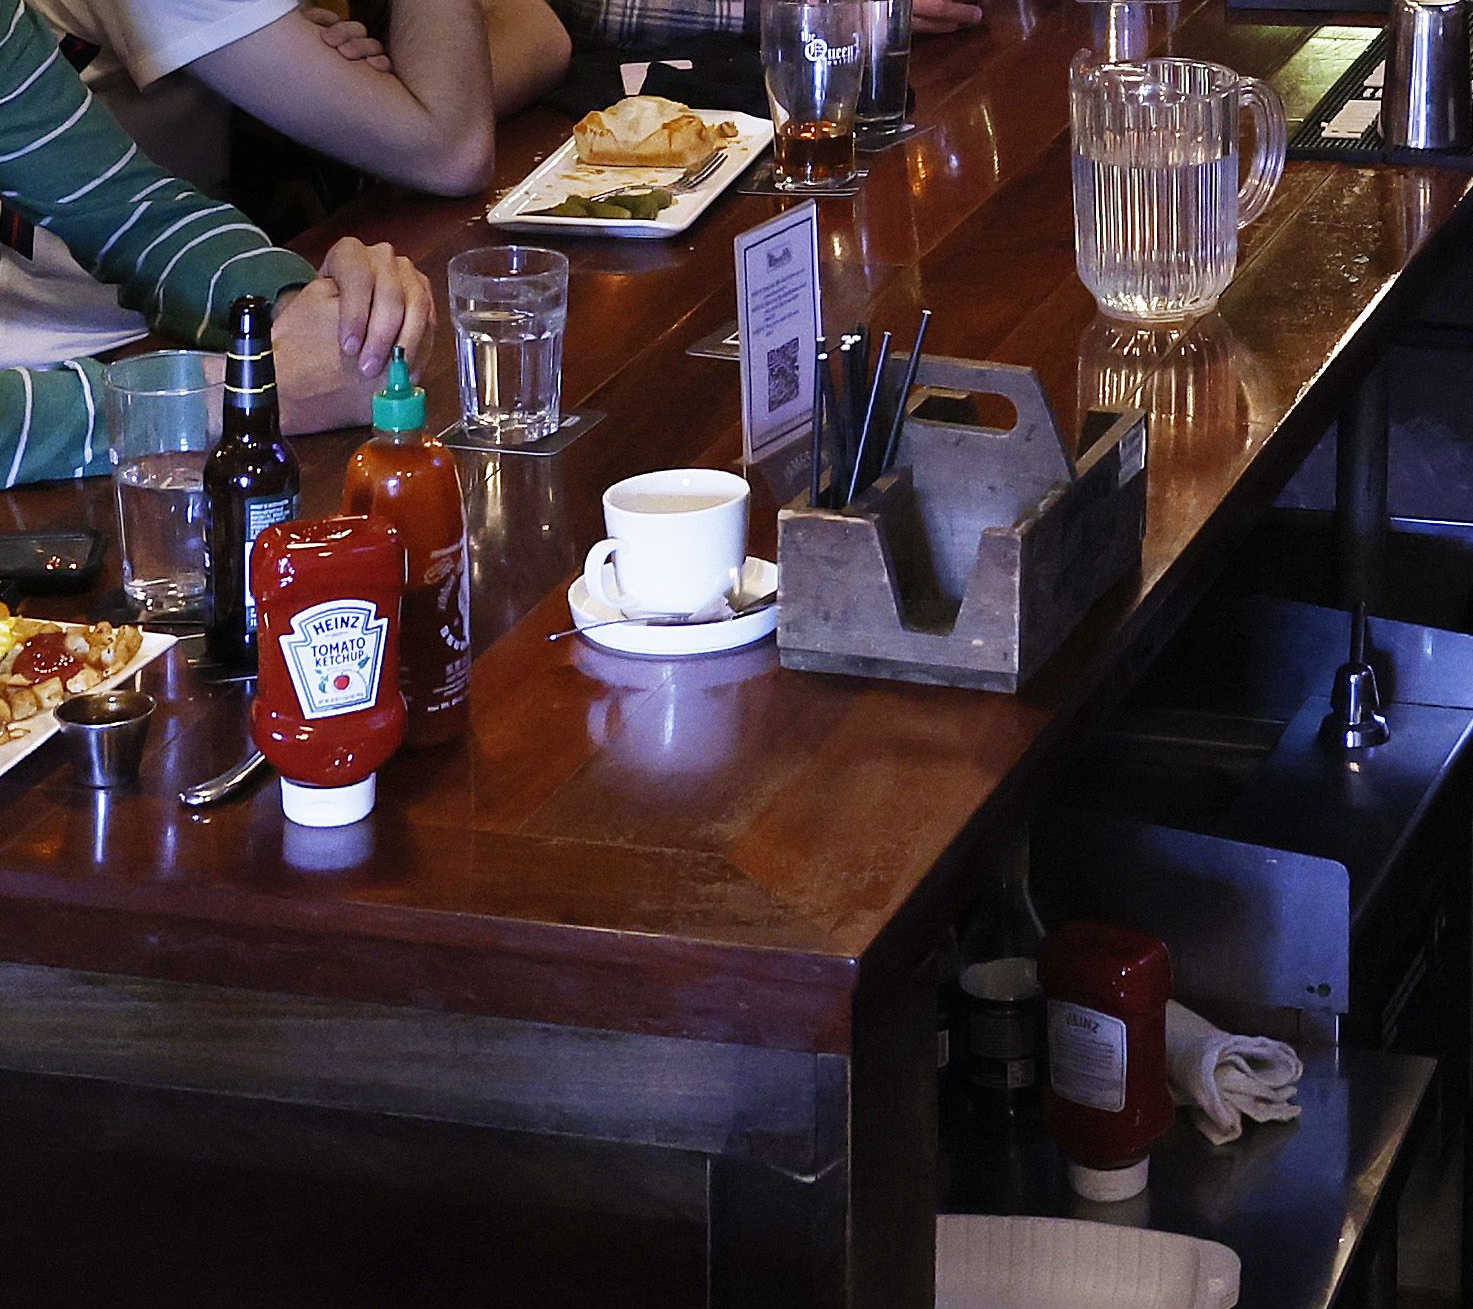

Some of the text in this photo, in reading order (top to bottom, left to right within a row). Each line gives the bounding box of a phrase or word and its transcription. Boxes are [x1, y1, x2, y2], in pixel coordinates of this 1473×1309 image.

[313, 616, 360, 635] HEINZ
[311, 637, 366, 658] TOMATO
[315, 651, 364, 668] KETCHUP
